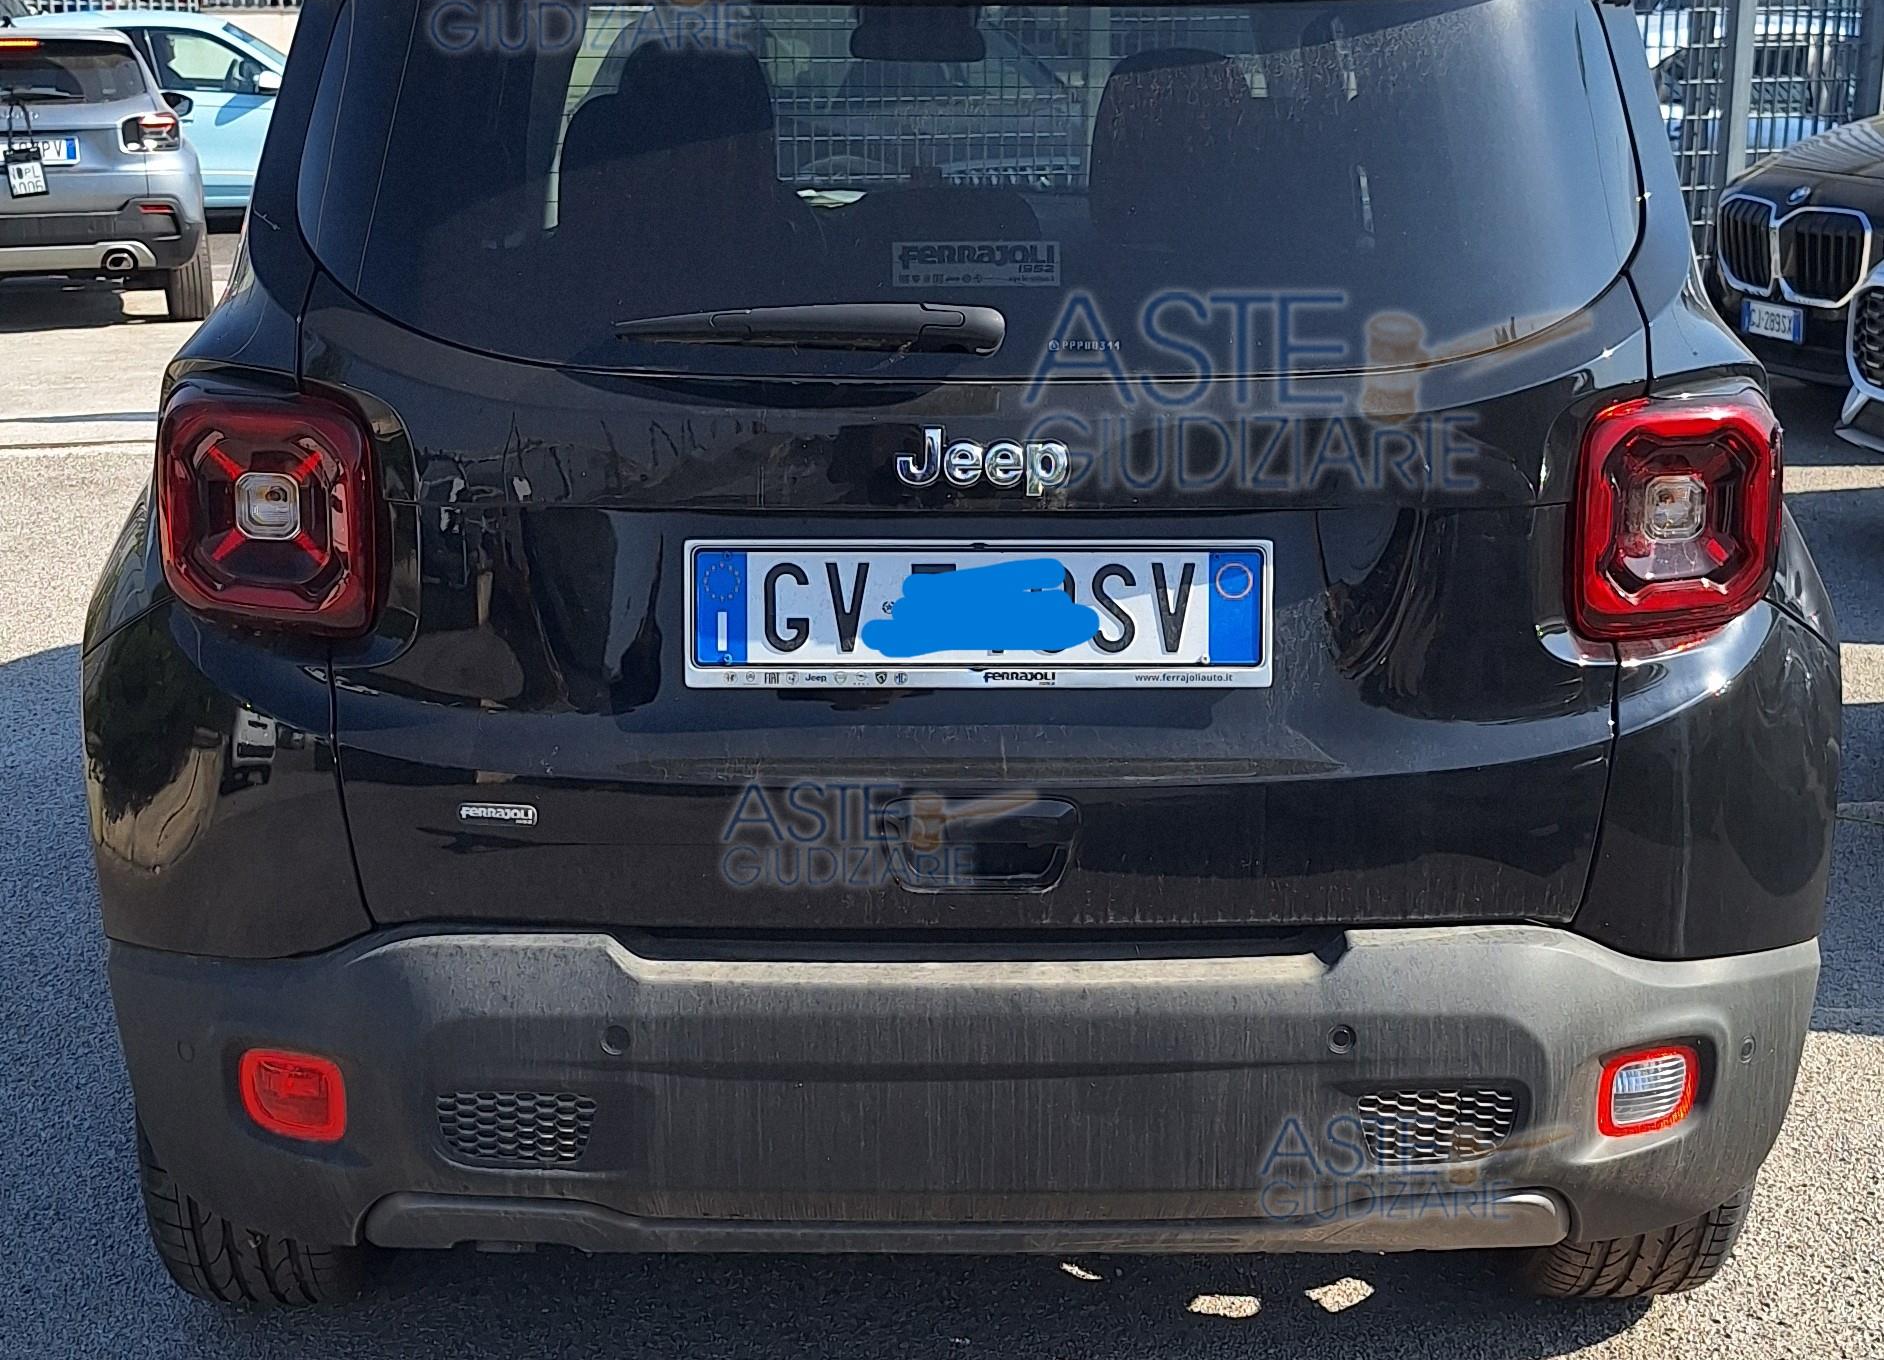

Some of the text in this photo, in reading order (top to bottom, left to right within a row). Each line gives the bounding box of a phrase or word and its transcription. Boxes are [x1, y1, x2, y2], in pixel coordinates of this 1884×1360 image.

[895, 426, 1071, 497] Jeep
[805, 673, 827, 683] Jeep
[1135, 672, 1233, 683] www.ferrajoliauto.it
